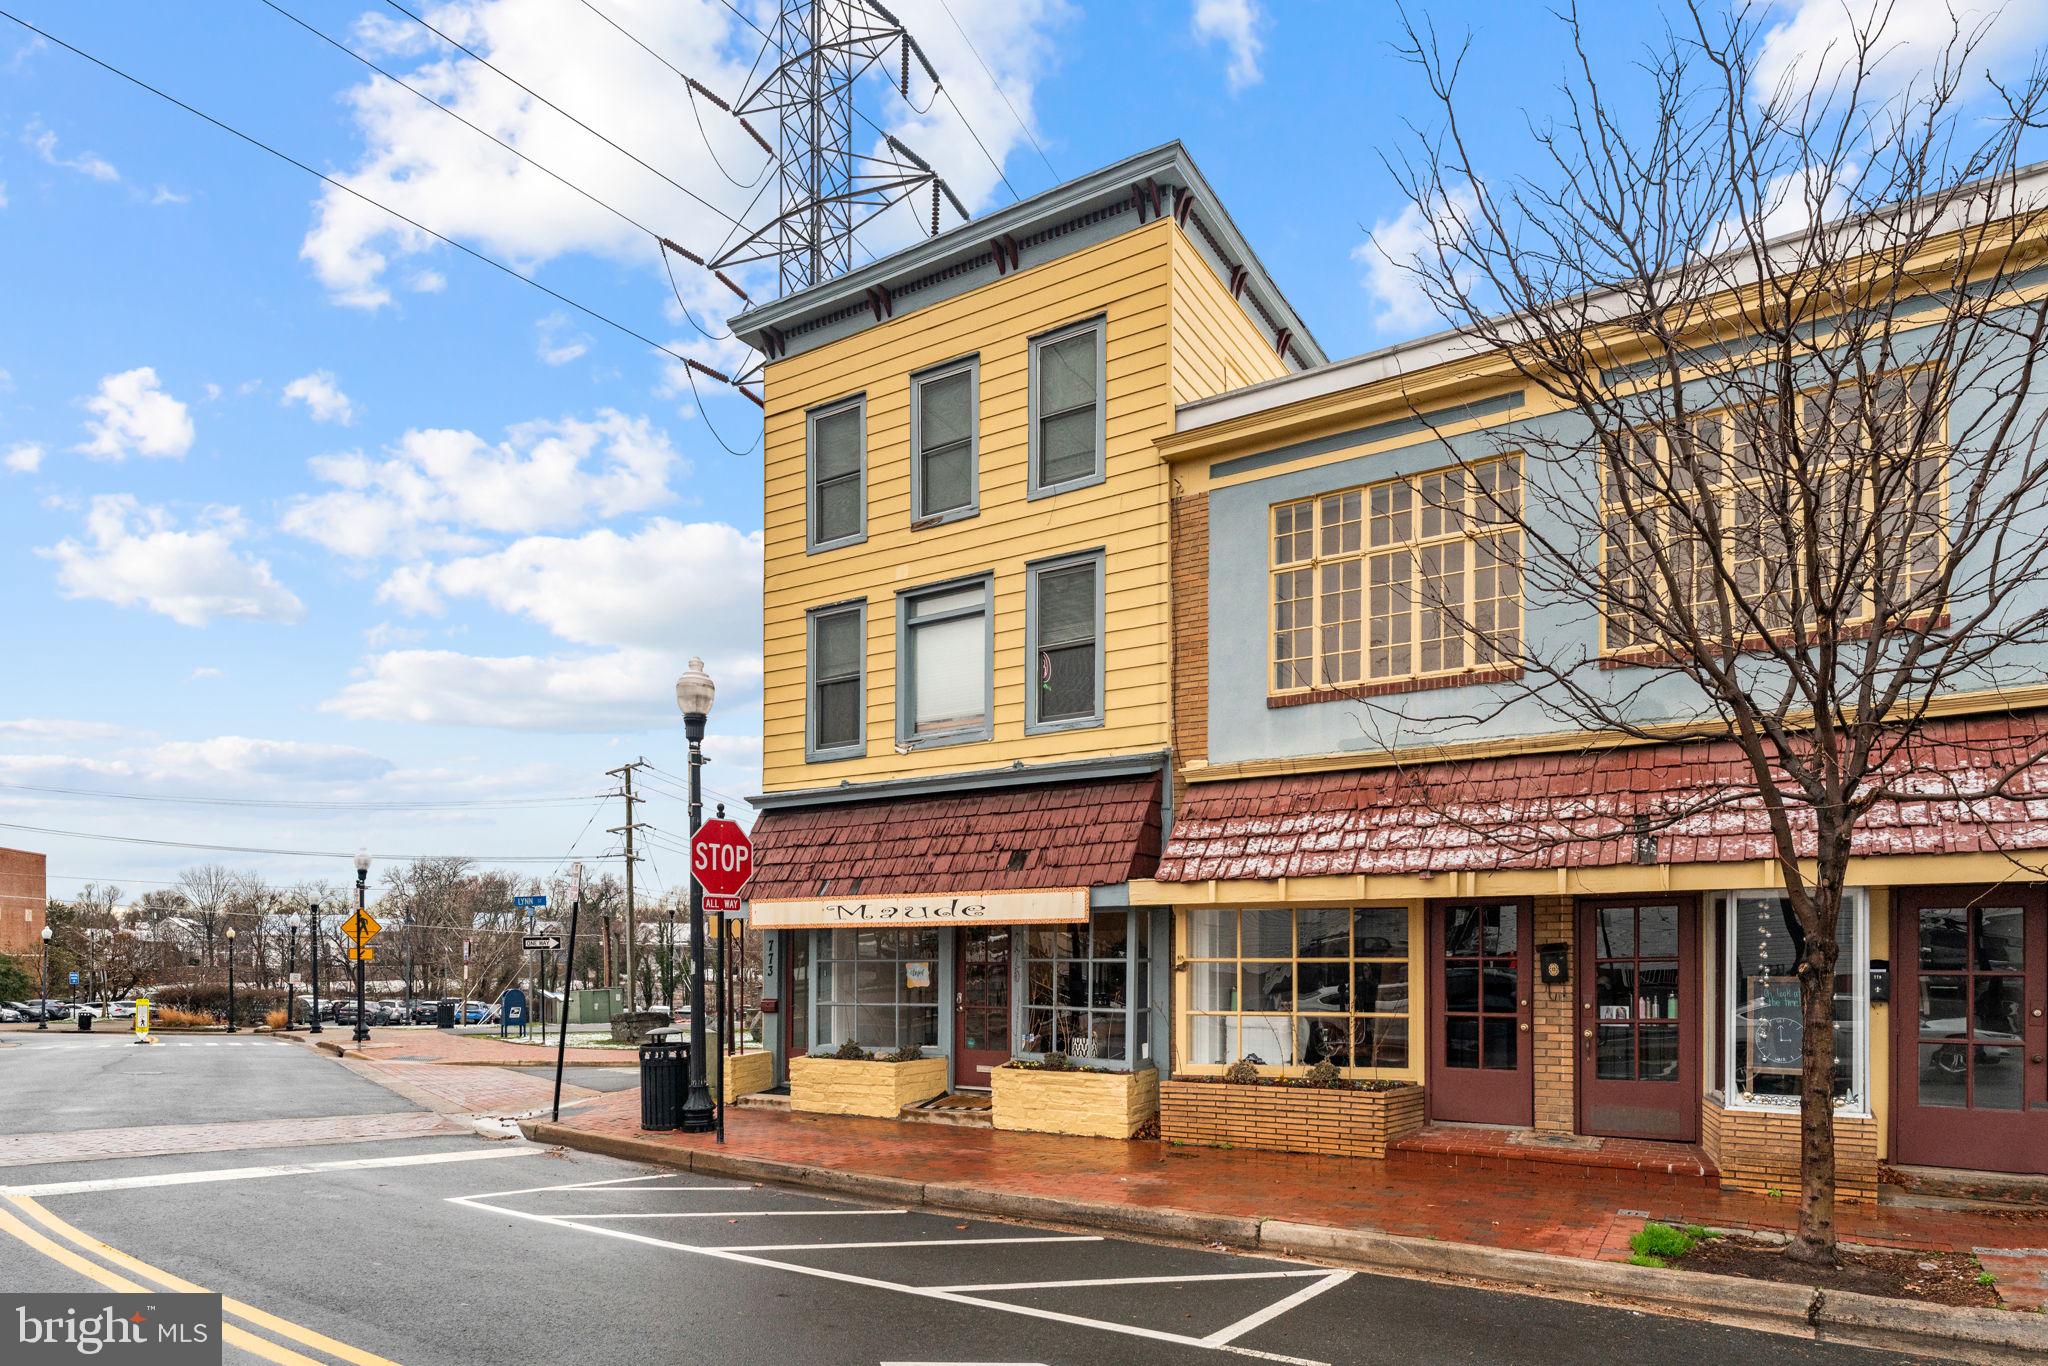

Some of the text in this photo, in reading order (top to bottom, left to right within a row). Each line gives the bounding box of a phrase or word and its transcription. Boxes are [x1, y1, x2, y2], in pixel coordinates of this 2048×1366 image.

[695, 841, 749, 873] STOP
[517, 897, 534, 906] LYNN
[705, 898, 738, 909] ALL WAY
[826, 899, 986, 920] Maude
